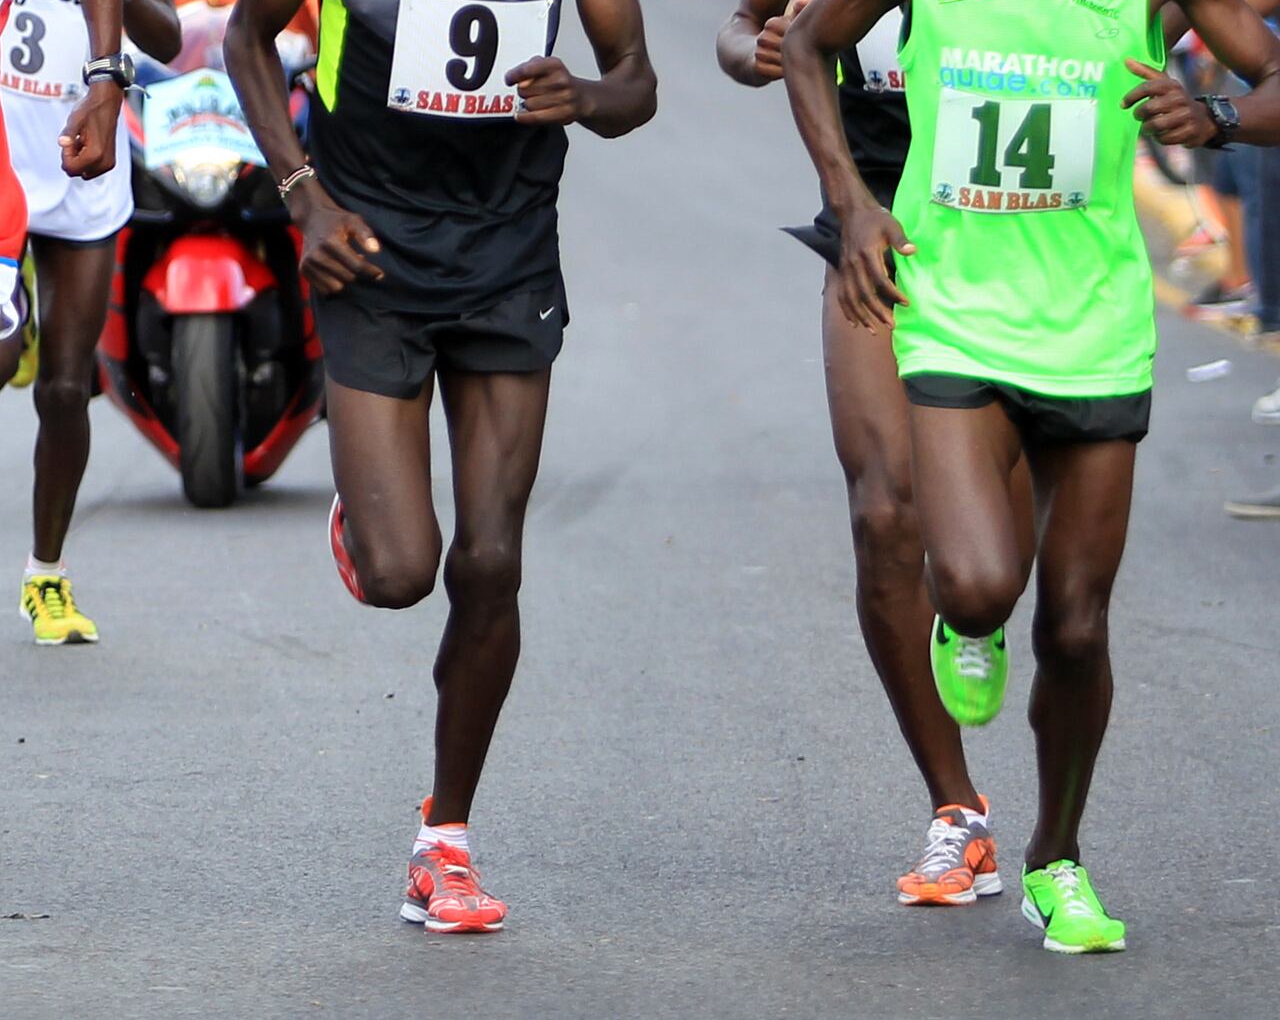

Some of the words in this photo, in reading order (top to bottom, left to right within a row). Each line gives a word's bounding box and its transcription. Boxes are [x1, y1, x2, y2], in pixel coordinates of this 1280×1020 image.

[446, 4, 499, 91] 9
[940, 47, 1104, 83] MARATHON
[23, 78, 62, 97] BLAS
[416, 90, 460, 113] SAN
[464, 94, 514, 114] BLAS
[969, 100, 1055, 189] 14
[958, 187, 1004, 209] SAN
[1007, 191, 1061, 209] BLAS
